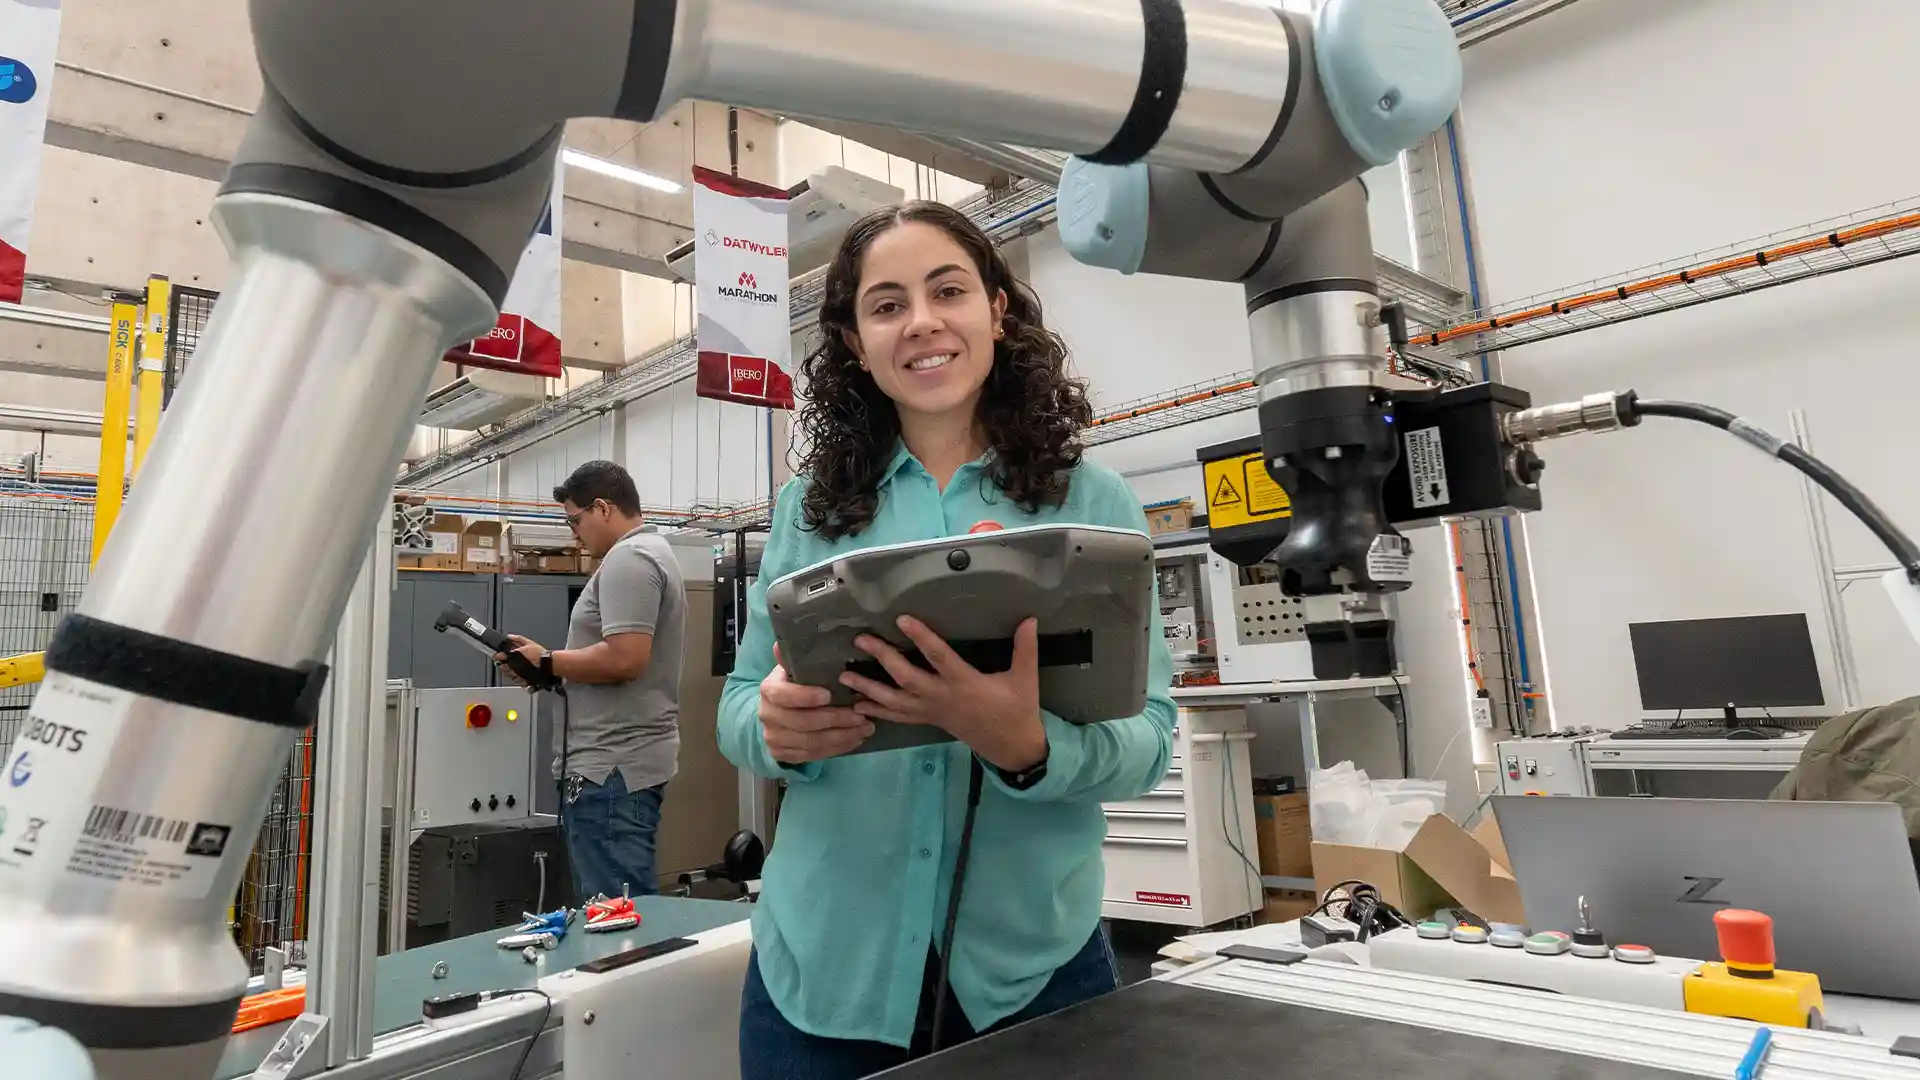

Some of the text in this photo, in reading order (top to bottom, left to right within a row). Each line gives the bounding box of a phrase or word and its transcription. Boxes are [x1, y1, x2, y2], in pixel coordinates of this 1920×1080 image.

[723, 236, 787, 259] DATWYLER
[718, 286, 778, 303] MARATHON
[115, 319, 130, 349] SICK
[486, 327, 516, 341] ERO
[733, 368, 763, 381] IBERO
[1408, 433, 1426, 503] AVOID EXPOSURE
